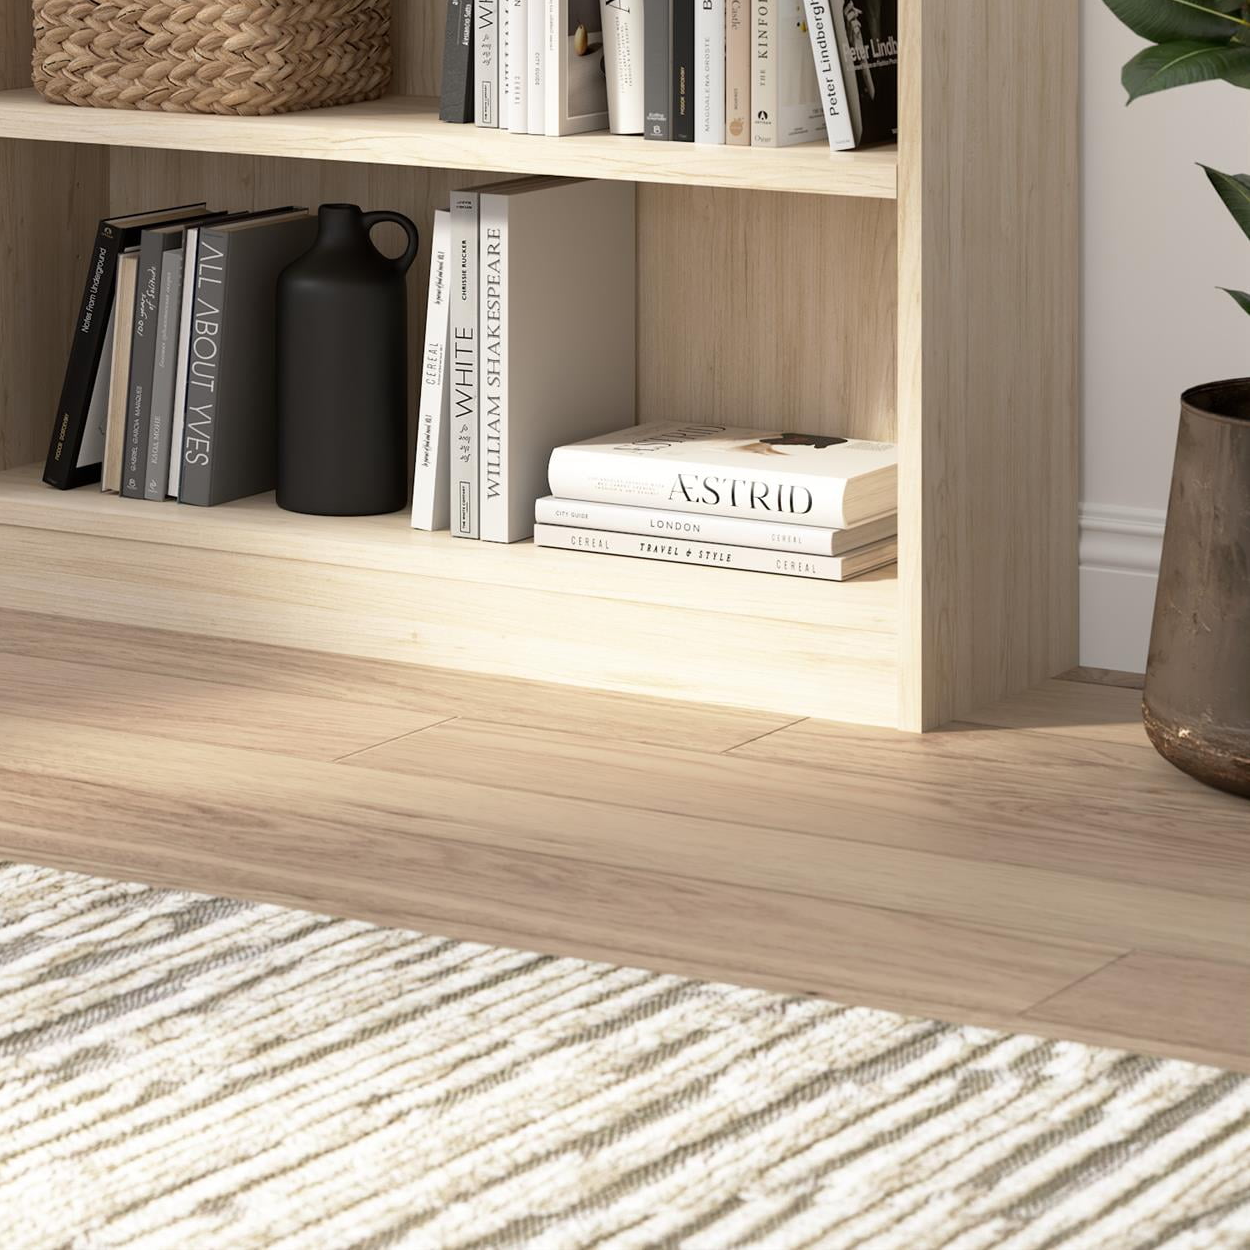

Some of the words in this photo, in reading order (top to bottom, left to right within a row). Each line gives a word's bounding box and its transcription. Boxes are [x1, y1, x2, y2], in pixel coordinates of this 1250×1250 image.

[732, 0, 742, 30] Castle
[843, 44, 870, 63] Peter
[870, 36, 898, 59] Lindb
[826, 78, 840, 116] Peter
[91, 247, 107, 292] Underground
[198, 241, 224, 288] ALL
[81, 312, 93, 333] Notes
[86, 293, 97, 311] From
[487, 228, 500, 387] SHAKESPEARE
[190, 298, 220, 392] ABOUT
[426, 342, 438, 385] CEREAL
[455, 327, 474, 418] WHITE
[185, 404, 213, 466] YVES
[487, 396, 500, 499] WILLIAM
[668, 473, 812, 515] ÆSTRID
[650, 519, 700, 532] LONDON
[772, 533, 802, 544] CEREAL
[571, 536, 609, 549] CEREAL
[640, 543, 678, 556] TRAVEL
[699, 550, 732, 562] STYLE
[776, 560, 816, 573] CEREAL
